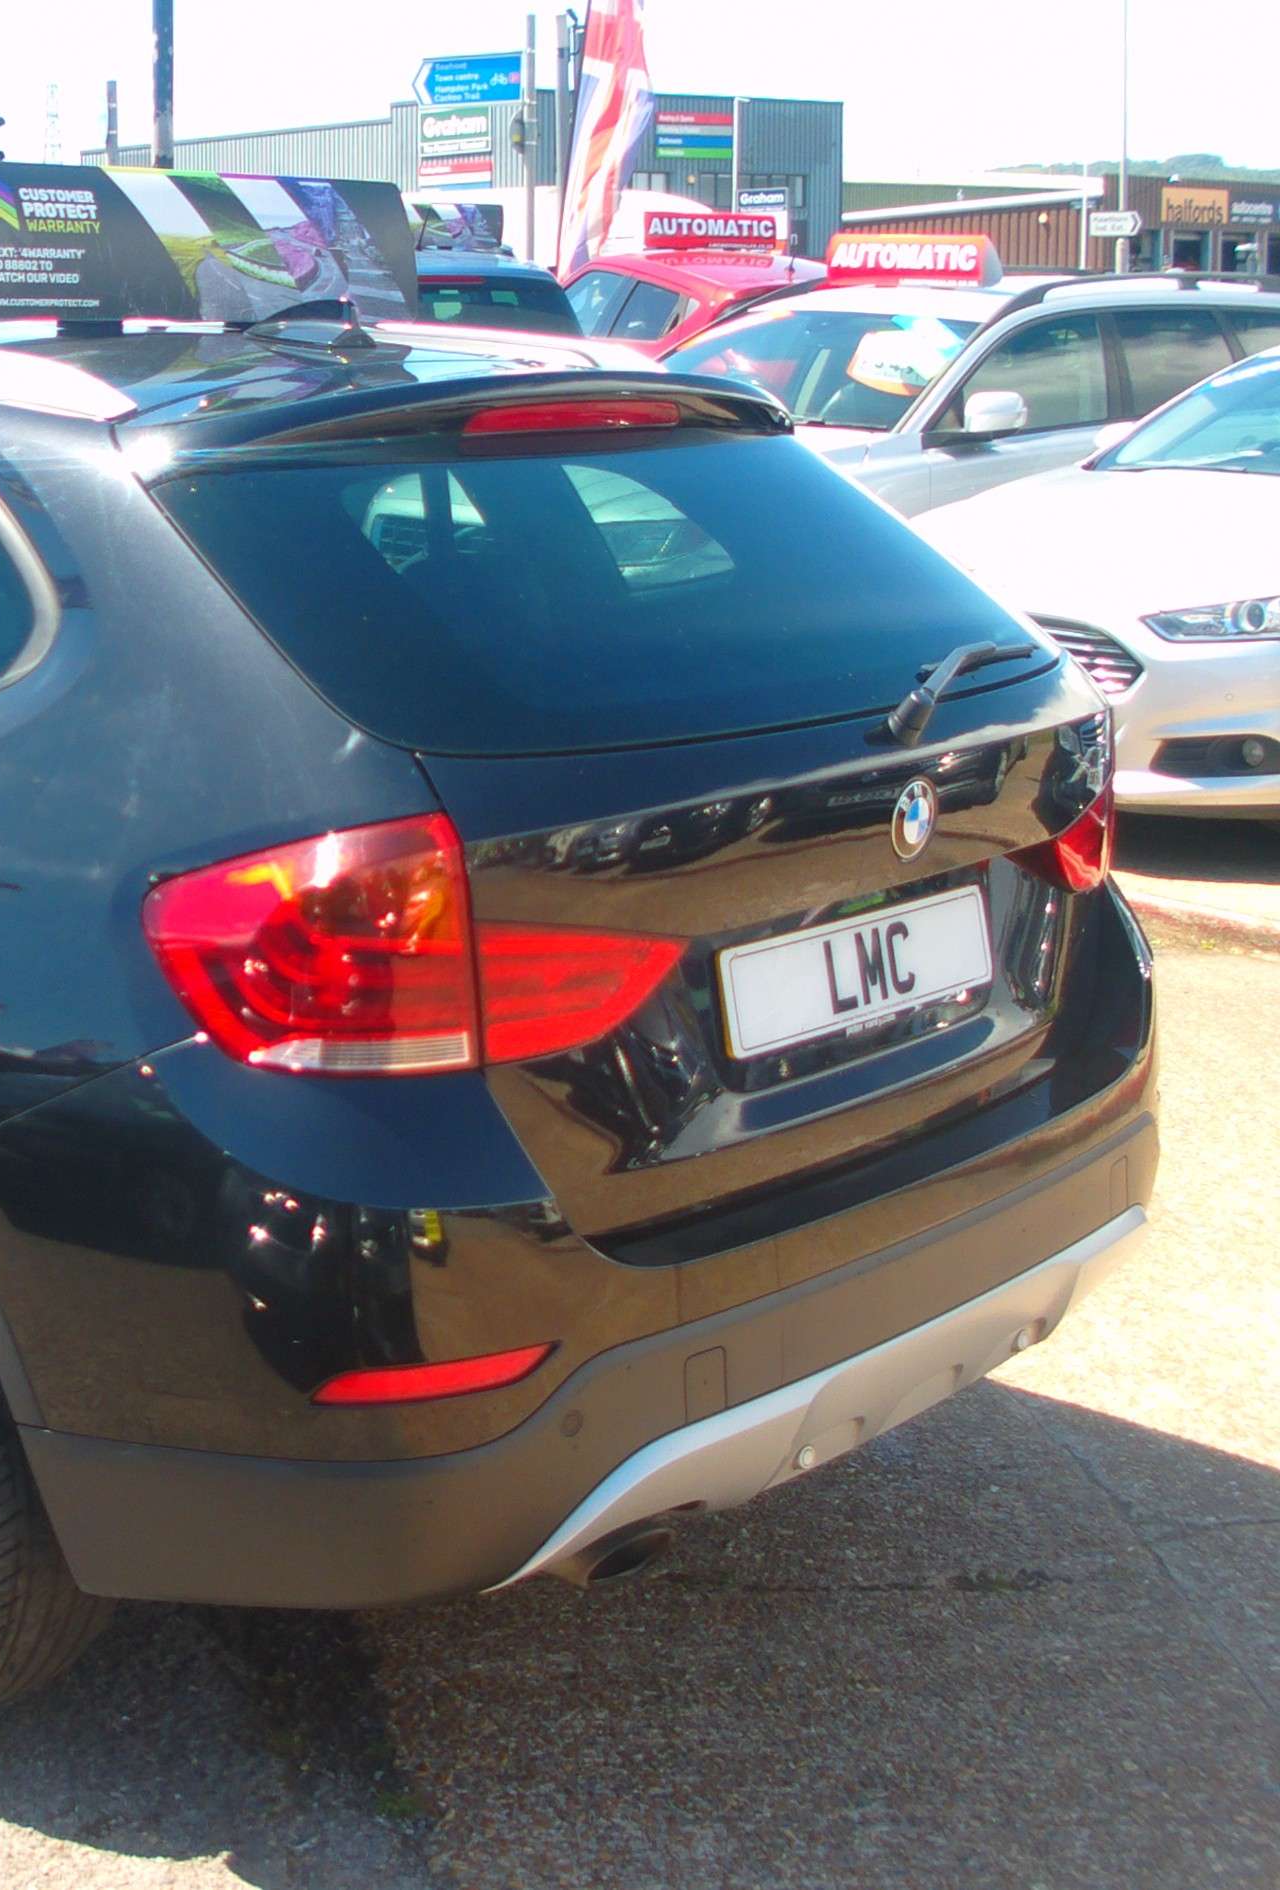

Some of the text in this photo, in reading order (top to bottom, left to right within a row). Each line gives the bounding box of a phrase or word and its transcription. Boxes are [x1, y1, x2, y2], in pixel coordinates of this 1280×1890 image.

[422, 114, 488, 138] Graham
[19, 188, 94, 202] CUSTOMER
[740, 193, 784, 204] Graham
[22, 202, 97, 219] PROTECT
[1167, 199, 1224, 223] halfords
[26, 220, 101, 234] WARRANTY
[649, 217, 773, 237] AUTOMATIC
[831, 243, 978, 271] AUTOMATIC
[40, 261, 53, 271] TO
[26, 273, 48, 283] OUR
[49, 274, 80, 284] VIDEO
[823, 920, 916, 1015] LMC
